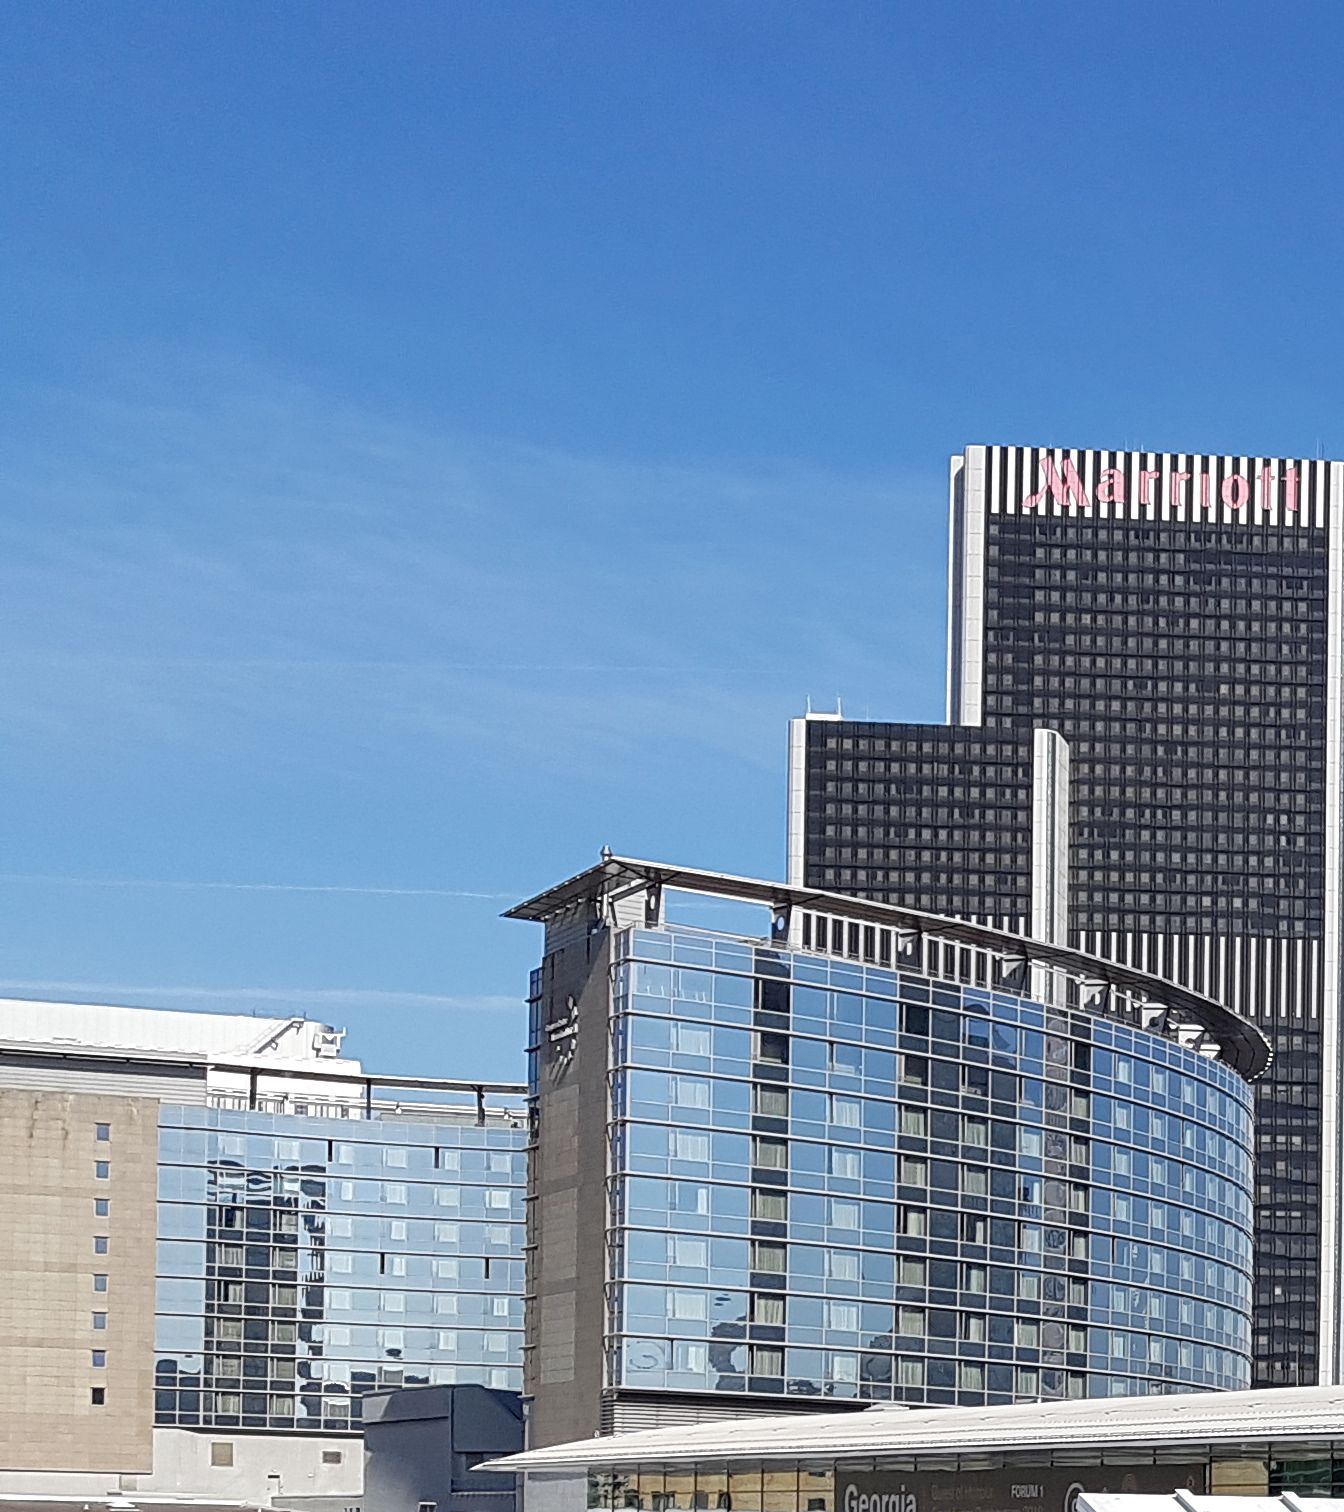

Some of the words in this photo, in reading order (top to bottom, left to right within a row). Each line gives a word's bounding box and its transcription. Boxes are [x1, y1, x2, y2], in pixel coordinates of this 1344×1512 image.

[1022, 455, 1300, 511] Marriott
[1011, 1484, 1039, 1498] FORUM
[1040, 1485, 1044, 1498] 1
